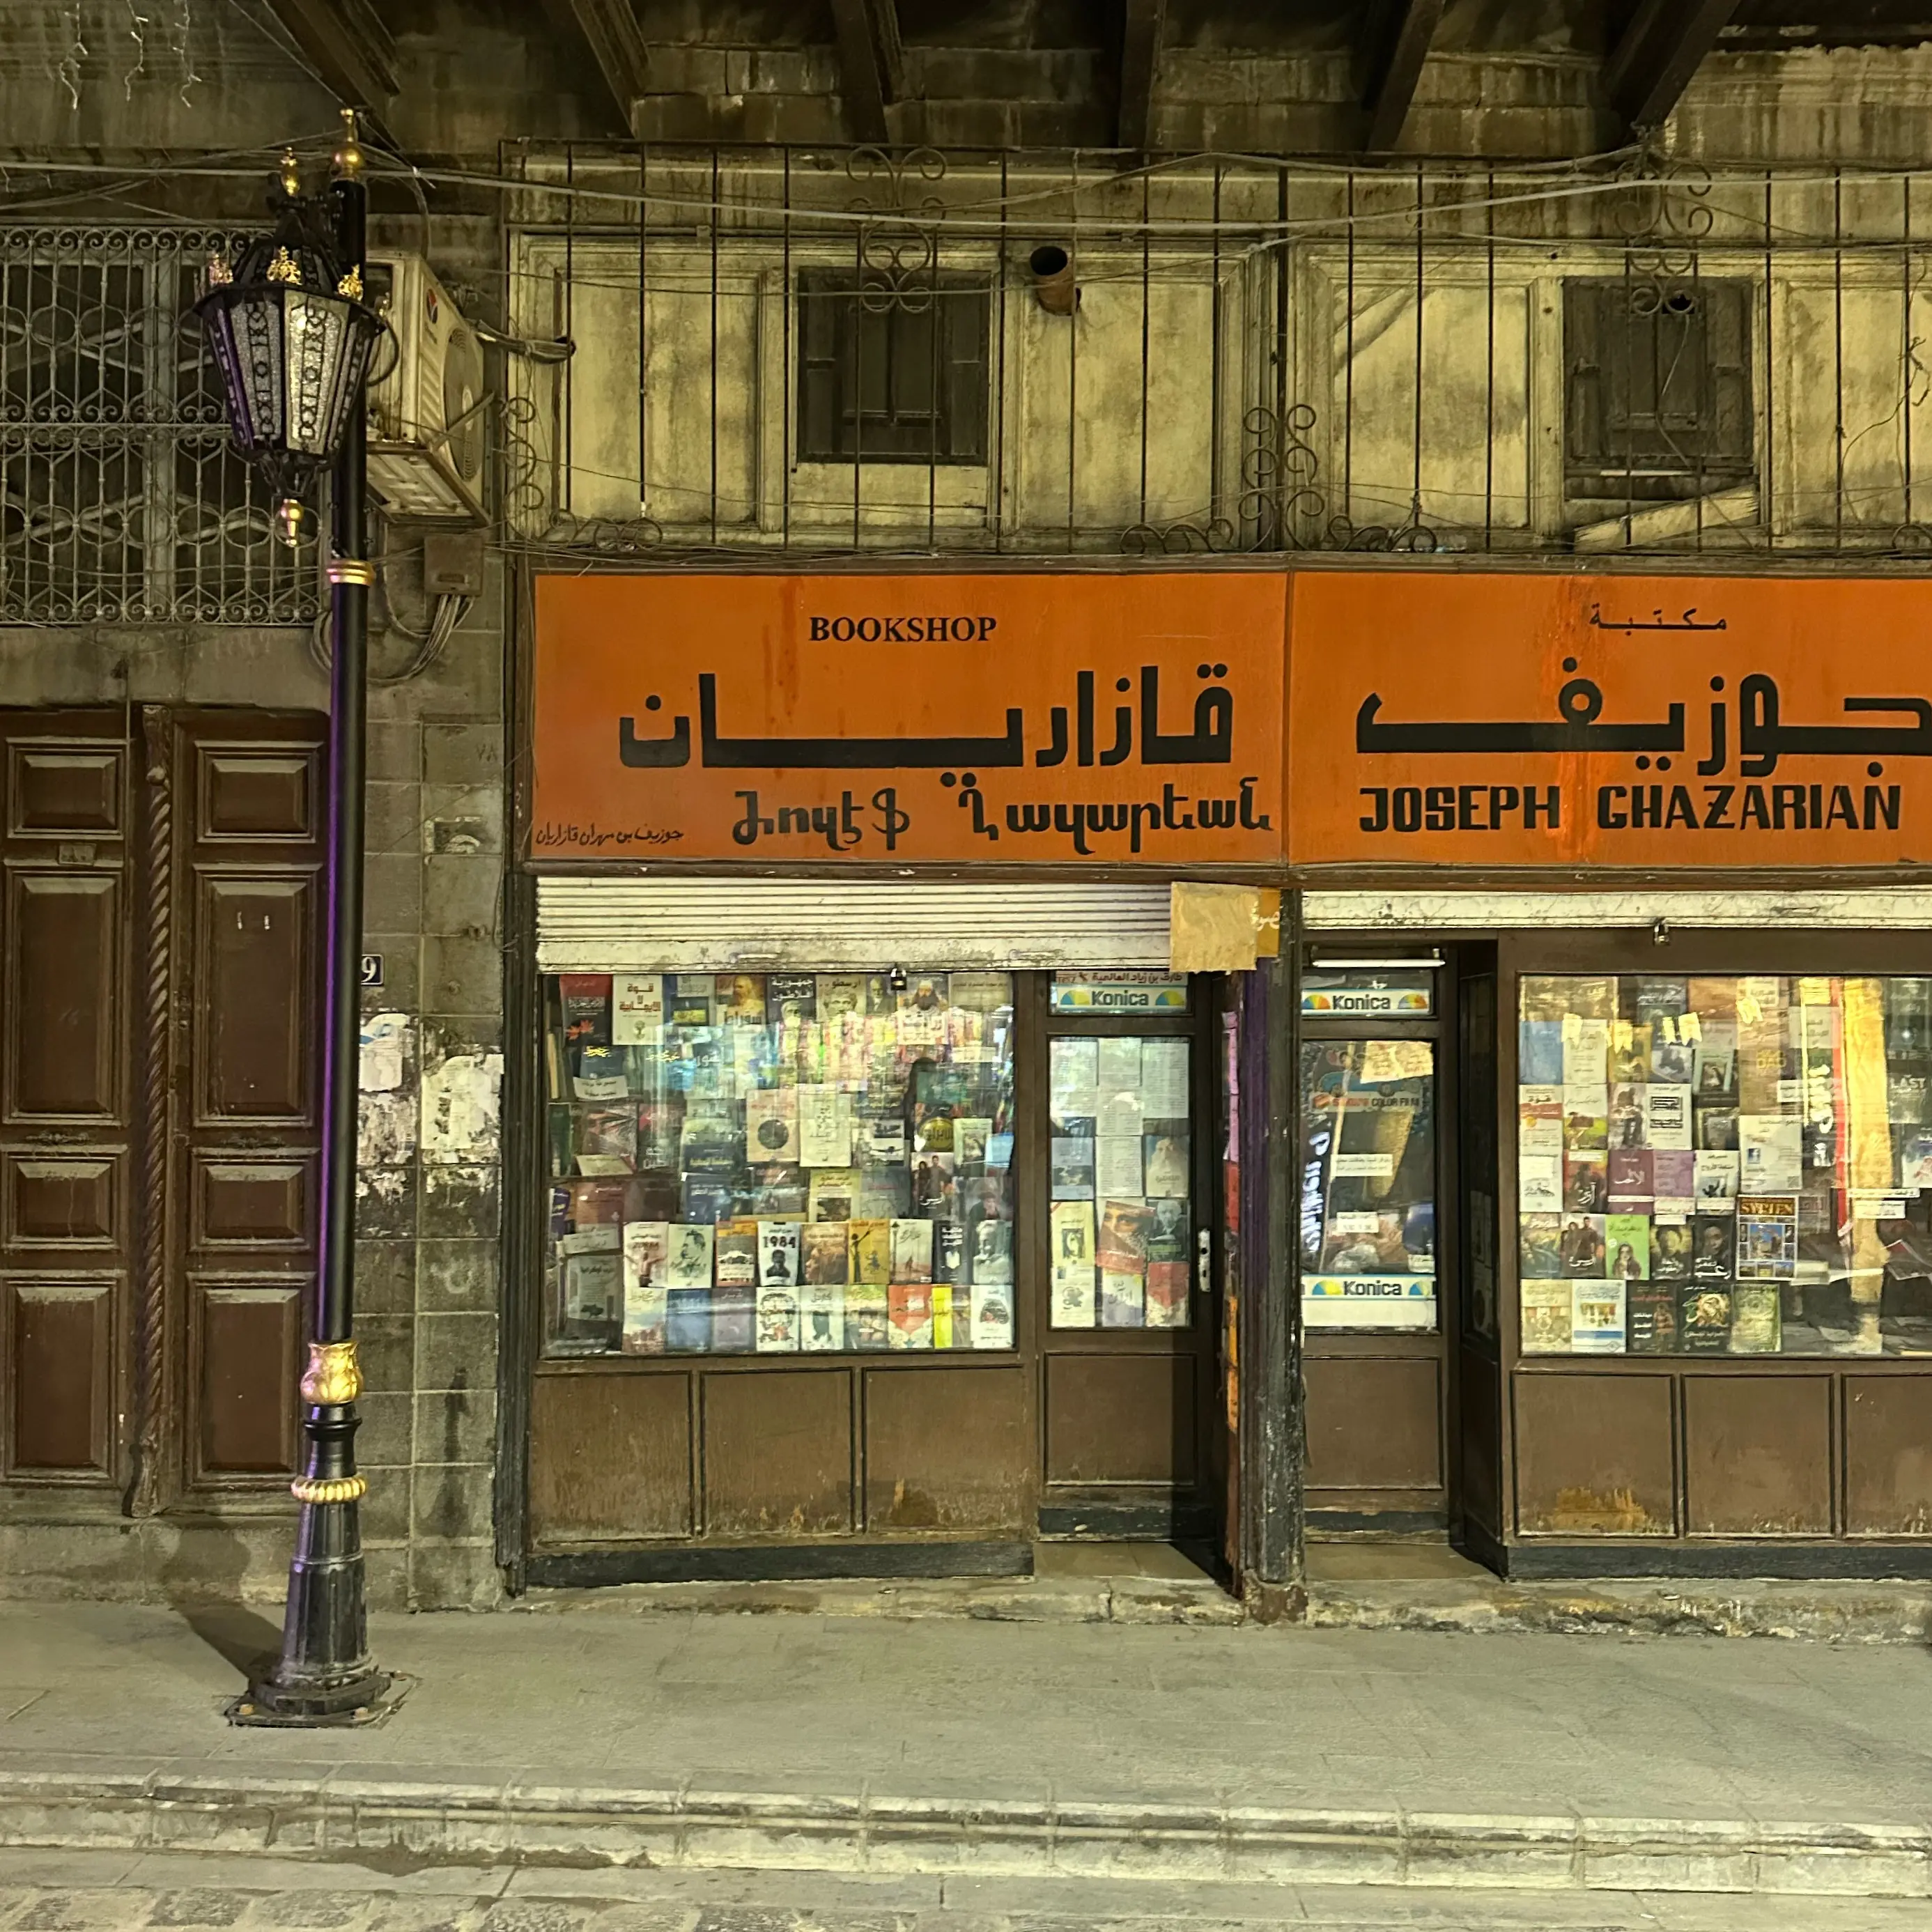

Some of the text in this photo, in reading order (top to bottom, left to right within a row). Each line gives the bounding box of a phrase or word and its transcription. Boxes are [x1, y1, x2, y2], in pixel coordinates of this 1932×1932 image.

[809, 617, 997, 642] BOOKSHOP
[1589, 601, 1727, 637] مكتبة
[619, 663, 1232, 788] قازاريان
[1356, 657, 1932, 778] جوزيف
[1359, 783, 1901, 833] JOSEPH GHAZARIAN
[616, 830, 632, 844] بن
[634, 823, 684, 844] جوزيف
[1091, 990, 1149, 1006] Konica
[1333, 994, 1391, 1010] Konica
[762, 1235, 796, 1249] 1984
[1343, 1280, 1402, 1296] Konica
